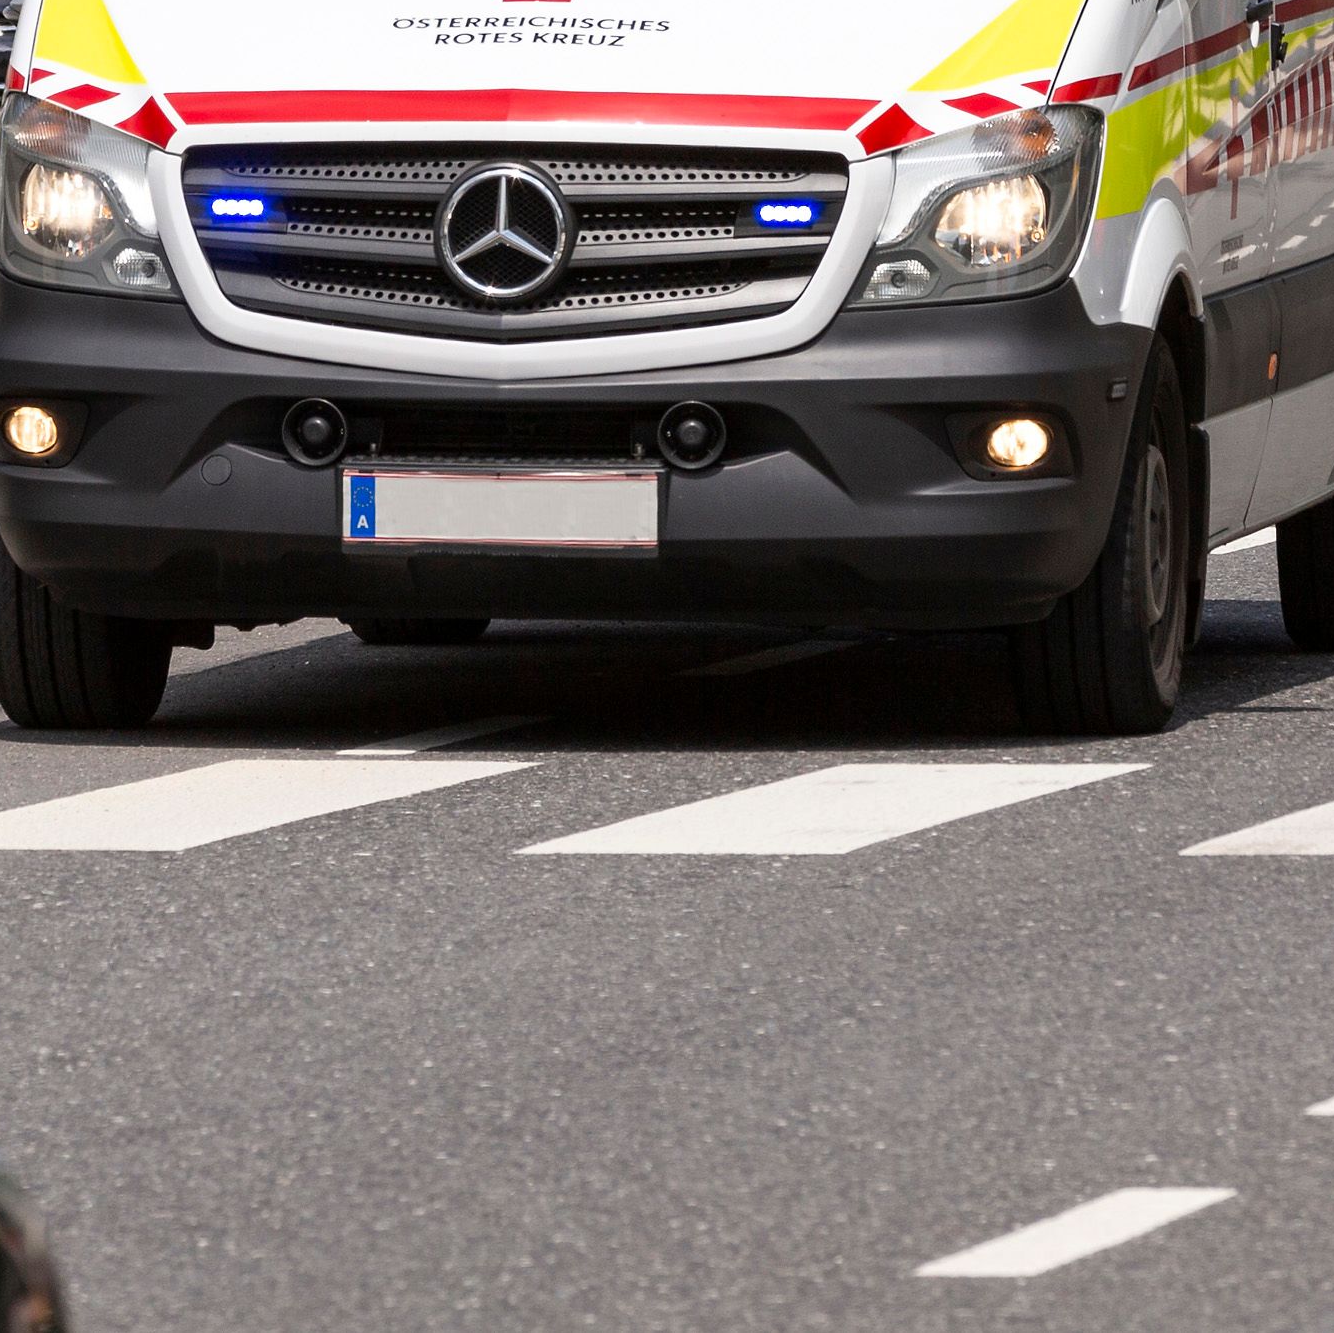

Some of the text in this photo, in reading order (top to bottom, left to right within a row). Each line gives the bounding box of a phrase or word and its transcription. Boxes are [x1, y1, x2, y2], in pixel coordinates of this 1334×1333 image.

[392, 16, 670, 32] ÖSTERREICHISCHES
[434, 32, 626, 47] ROTES KREUZ
[356, 515, 369, 530] A
